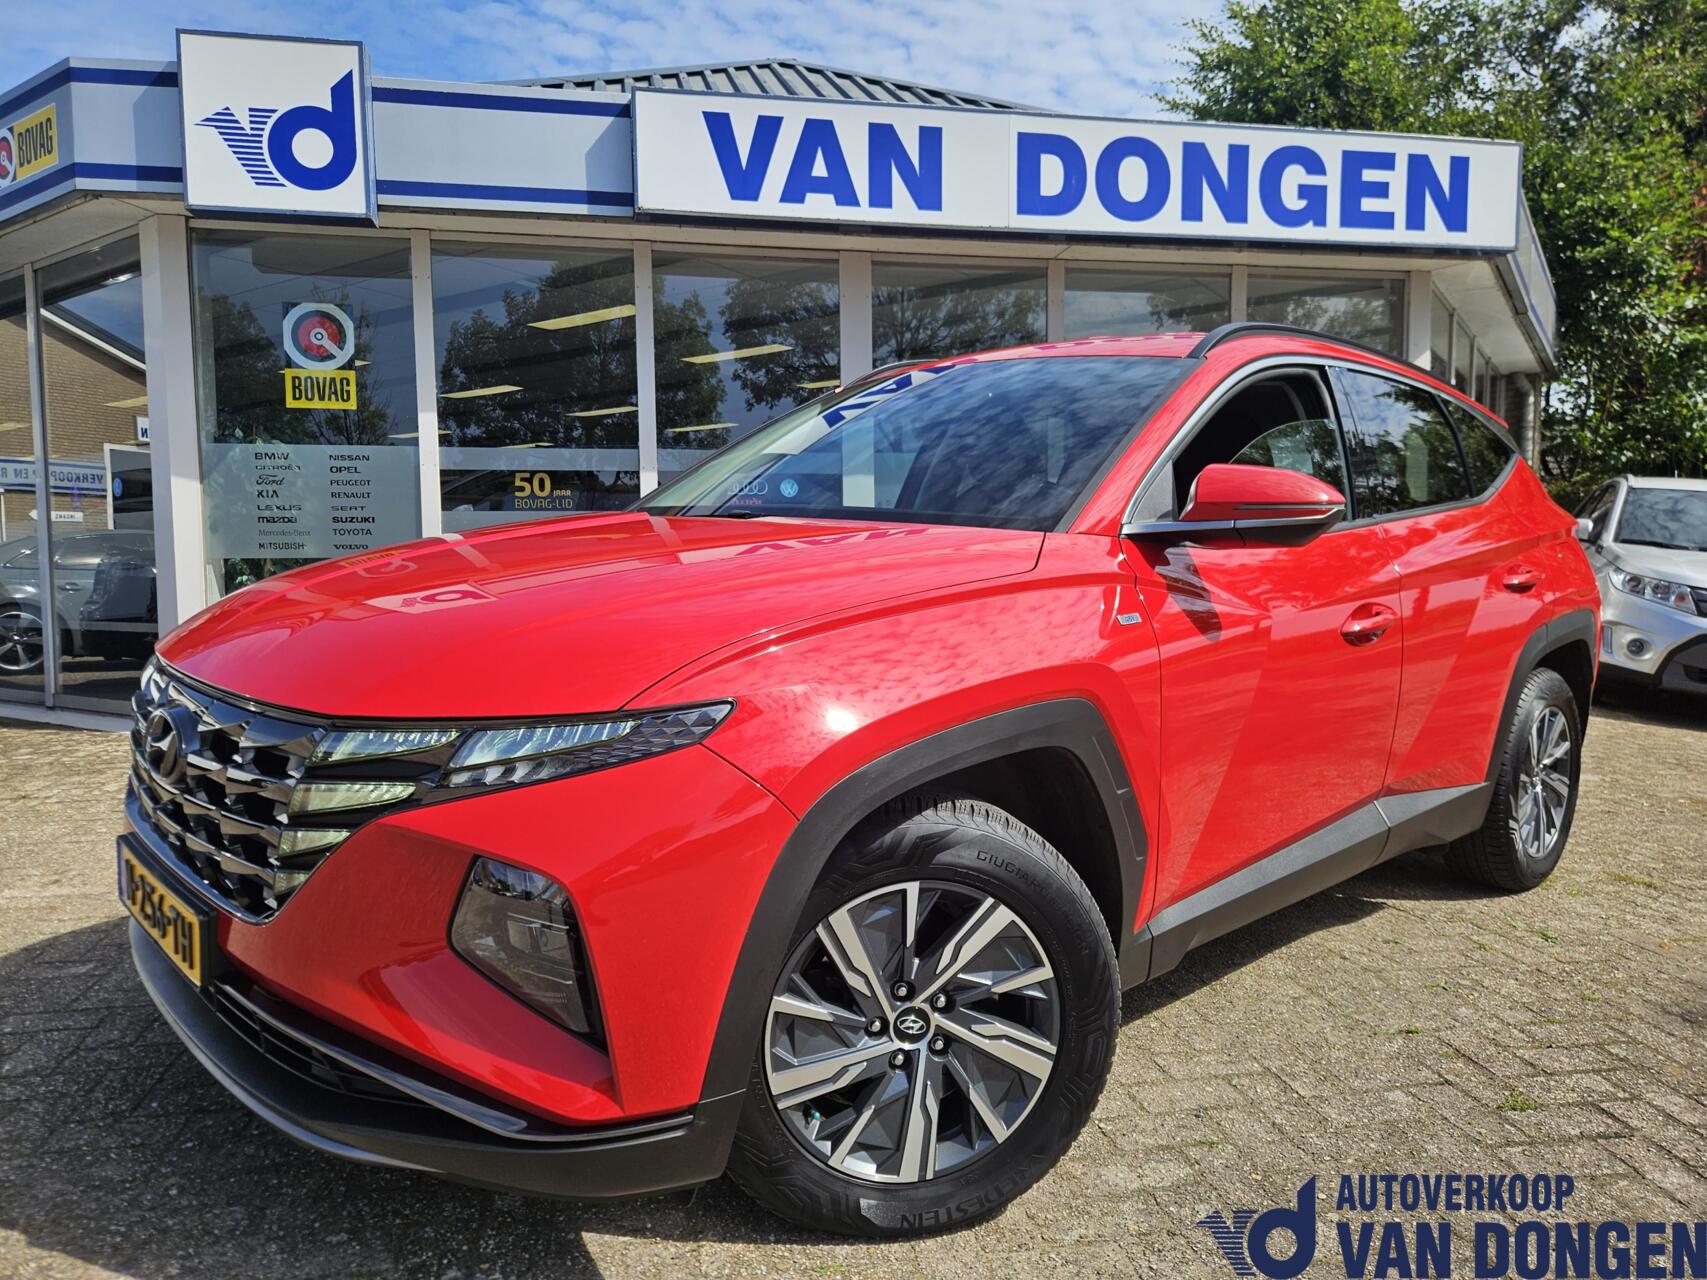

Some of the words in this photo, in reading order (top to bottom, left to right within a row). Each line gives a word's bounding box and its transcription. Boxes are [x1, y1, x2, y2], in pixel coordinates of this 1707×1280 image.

[17, 116, 54, 169] BOVAG
[702, 110, 943, 212] VAN
[1016, 131, 1470, 232] DONGEN
[291, 375, 351, 403] BOVAG
[254, 452, 289, 460] BMW
[329, 465, 361, 474] OPEL
[256, 473, 285, 486] Ford
[514, 472, 552, 498] 50
[553, 489, 572, 498] JAAR
[256, 489, 279, 499] KIA
[331, 491, 372, 499] RENAULT
[515, 499, 573, 509] BOVAG-LID
[332, 516, 375, 524] SUZUKI
[332, 528, 372, 536] TOYOTA
